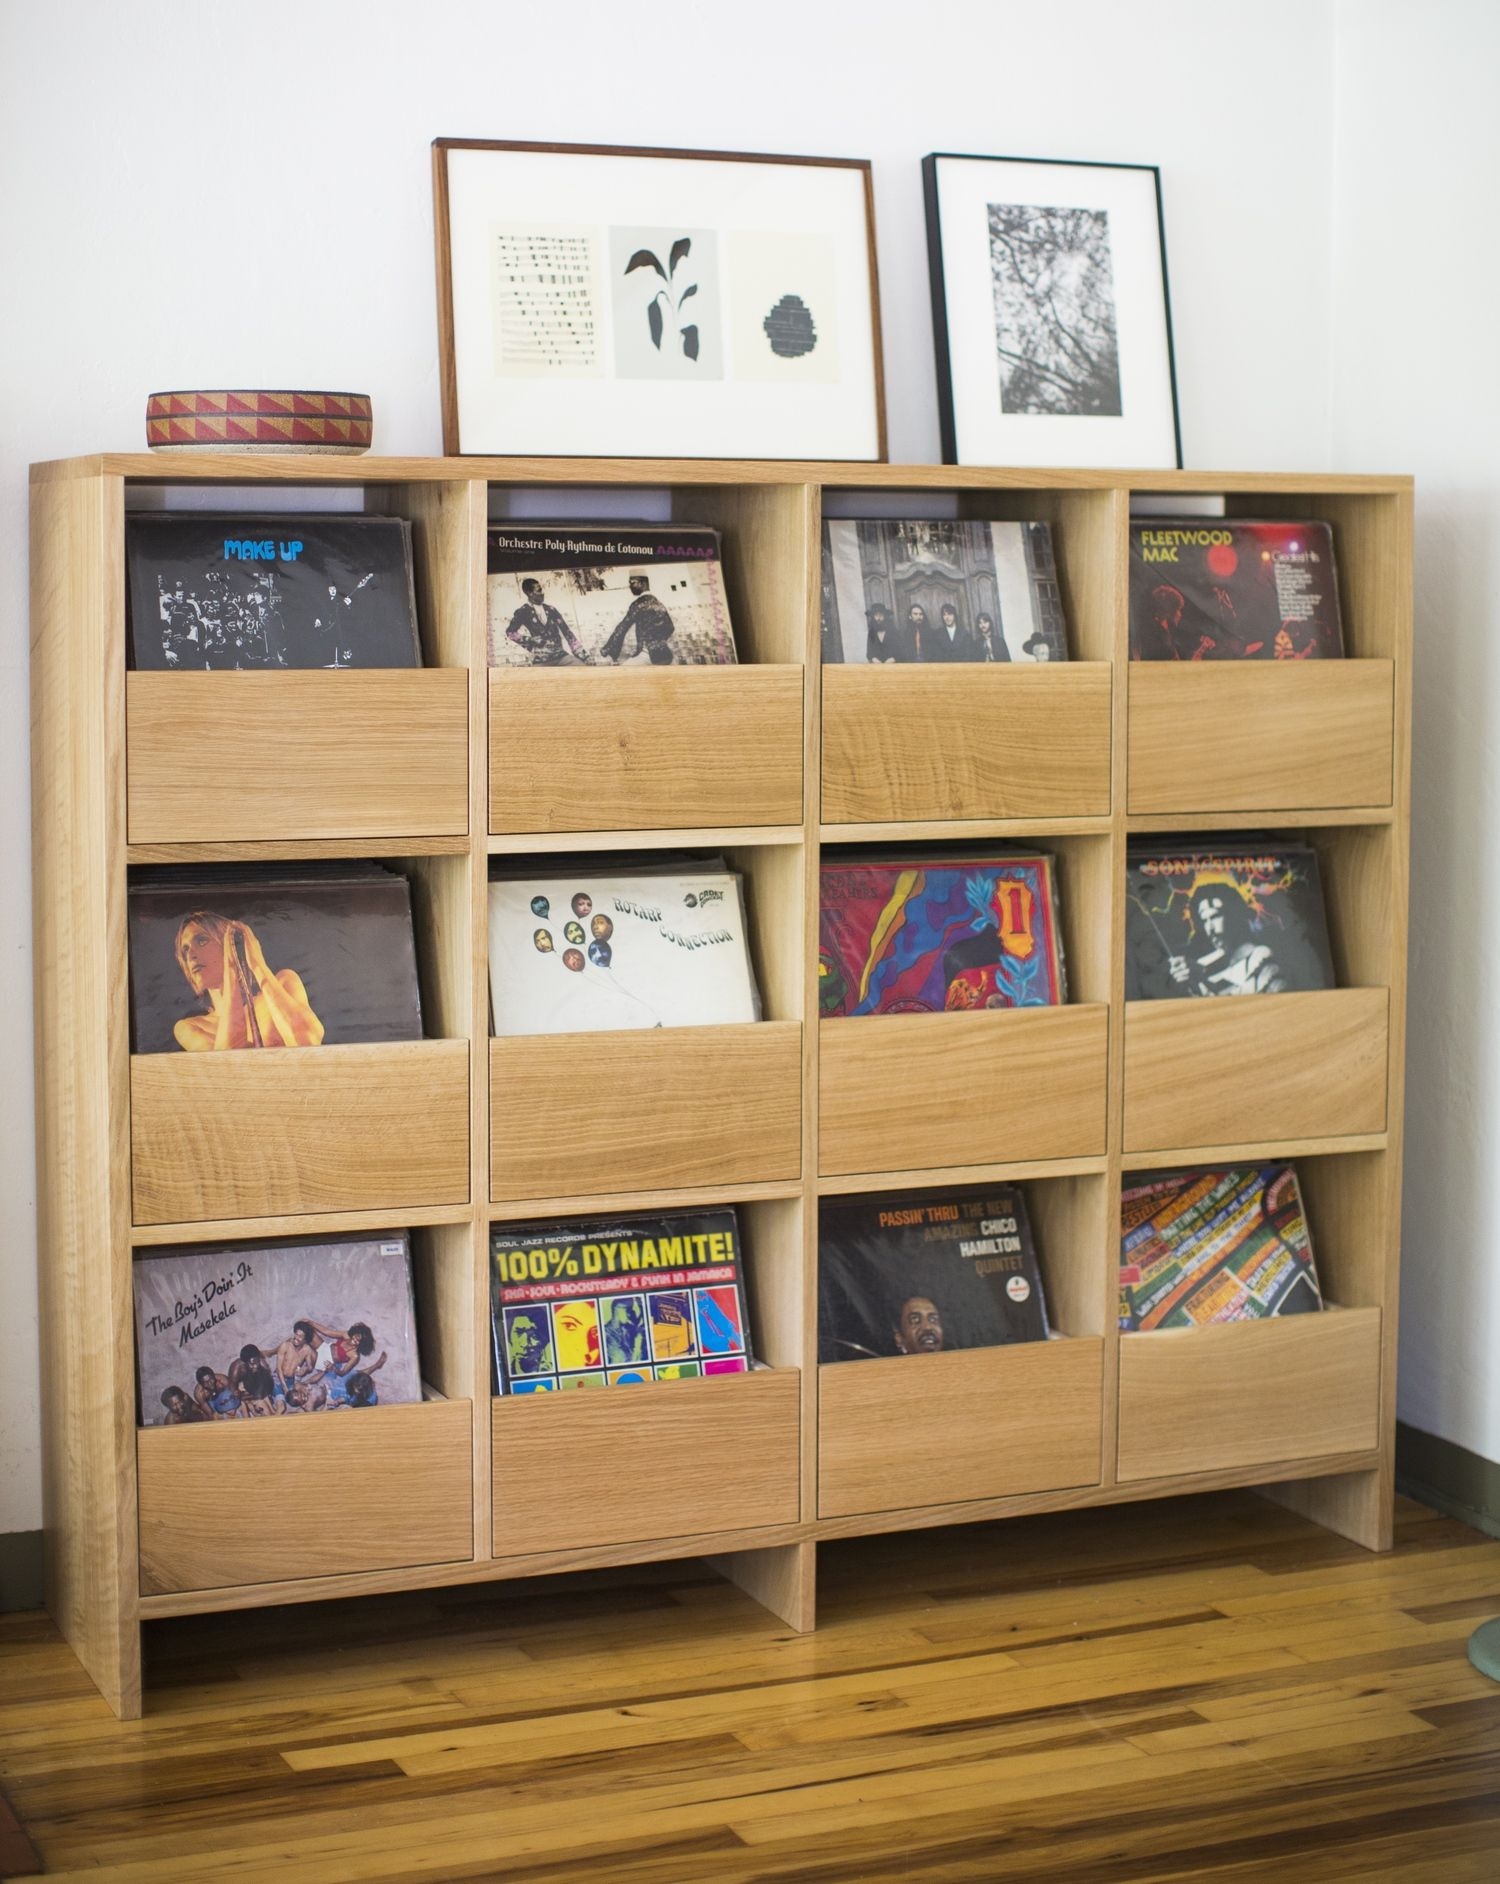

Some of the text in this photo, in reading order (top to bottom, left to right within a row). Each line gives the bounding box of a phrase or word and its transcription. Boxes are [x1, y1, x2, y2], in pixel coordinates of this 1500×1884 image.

[499, 536, 543, 549] Orchestre
[604, 542, 616, 553] de
[617, 542, 654, 555] Cotonou
[1141, 530, 1233, 546] FLEETWOOD
[224, 540, 303, 561] MAKE UP
[1143, 547, 1179, 562] MAC
[659, 926, 734, 951] CONNECTION
[879, 1200, 1014, 1227] PASSIN' THRU THE NEW
[521, 1238, 543, 1246] JAZZ
[545, 1234, 586, 1244] RECORDS
[588, 1230, 633, 1240] PRESENTS
[924, 1218, 1018, 1242] AMAZING CHICO
[496, 1232, 736, 1282] 100% DYNAMITE!
[959, 1236, 1022, 1258] HAMILTON
[975, 1256, 1025, 1278] QUINTET
[145, 1262, 253, 1336] The Boy's Doin' It
[179, 1301, 237, 1348] Masekela
